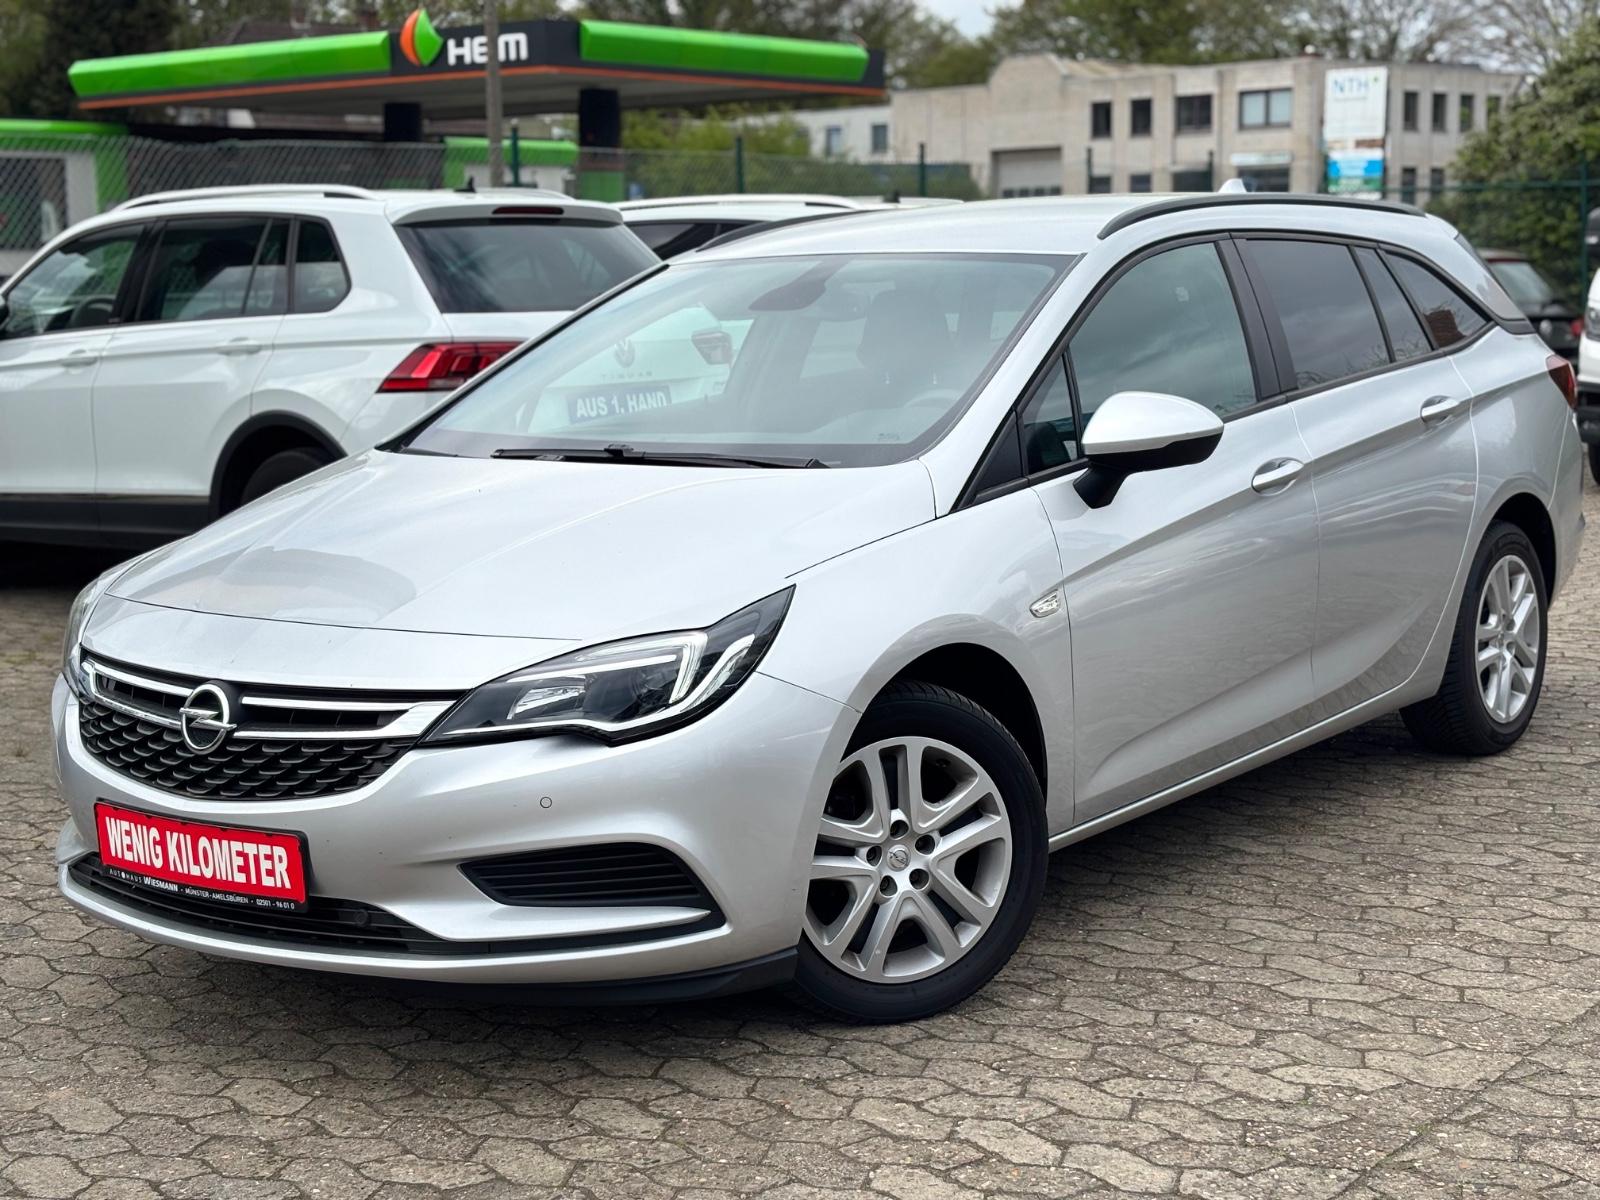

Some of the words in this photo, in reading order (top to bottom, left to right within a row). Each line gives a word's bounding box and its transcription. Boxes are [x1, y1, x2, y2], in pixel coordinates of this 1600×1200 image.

[447, 32, 528, 66] HEM
[1333, 77, 1369, 93] NTH
[576, 396, 608, 418] AUS
[611, 395, 625, 415] 1.
[628, 391, 667, 413] HAND
[105, 816, 163, 869] WENIG
[165, 831, 291, 889] KILOMETER
[143, 876, 179, 892] WIESMANN
